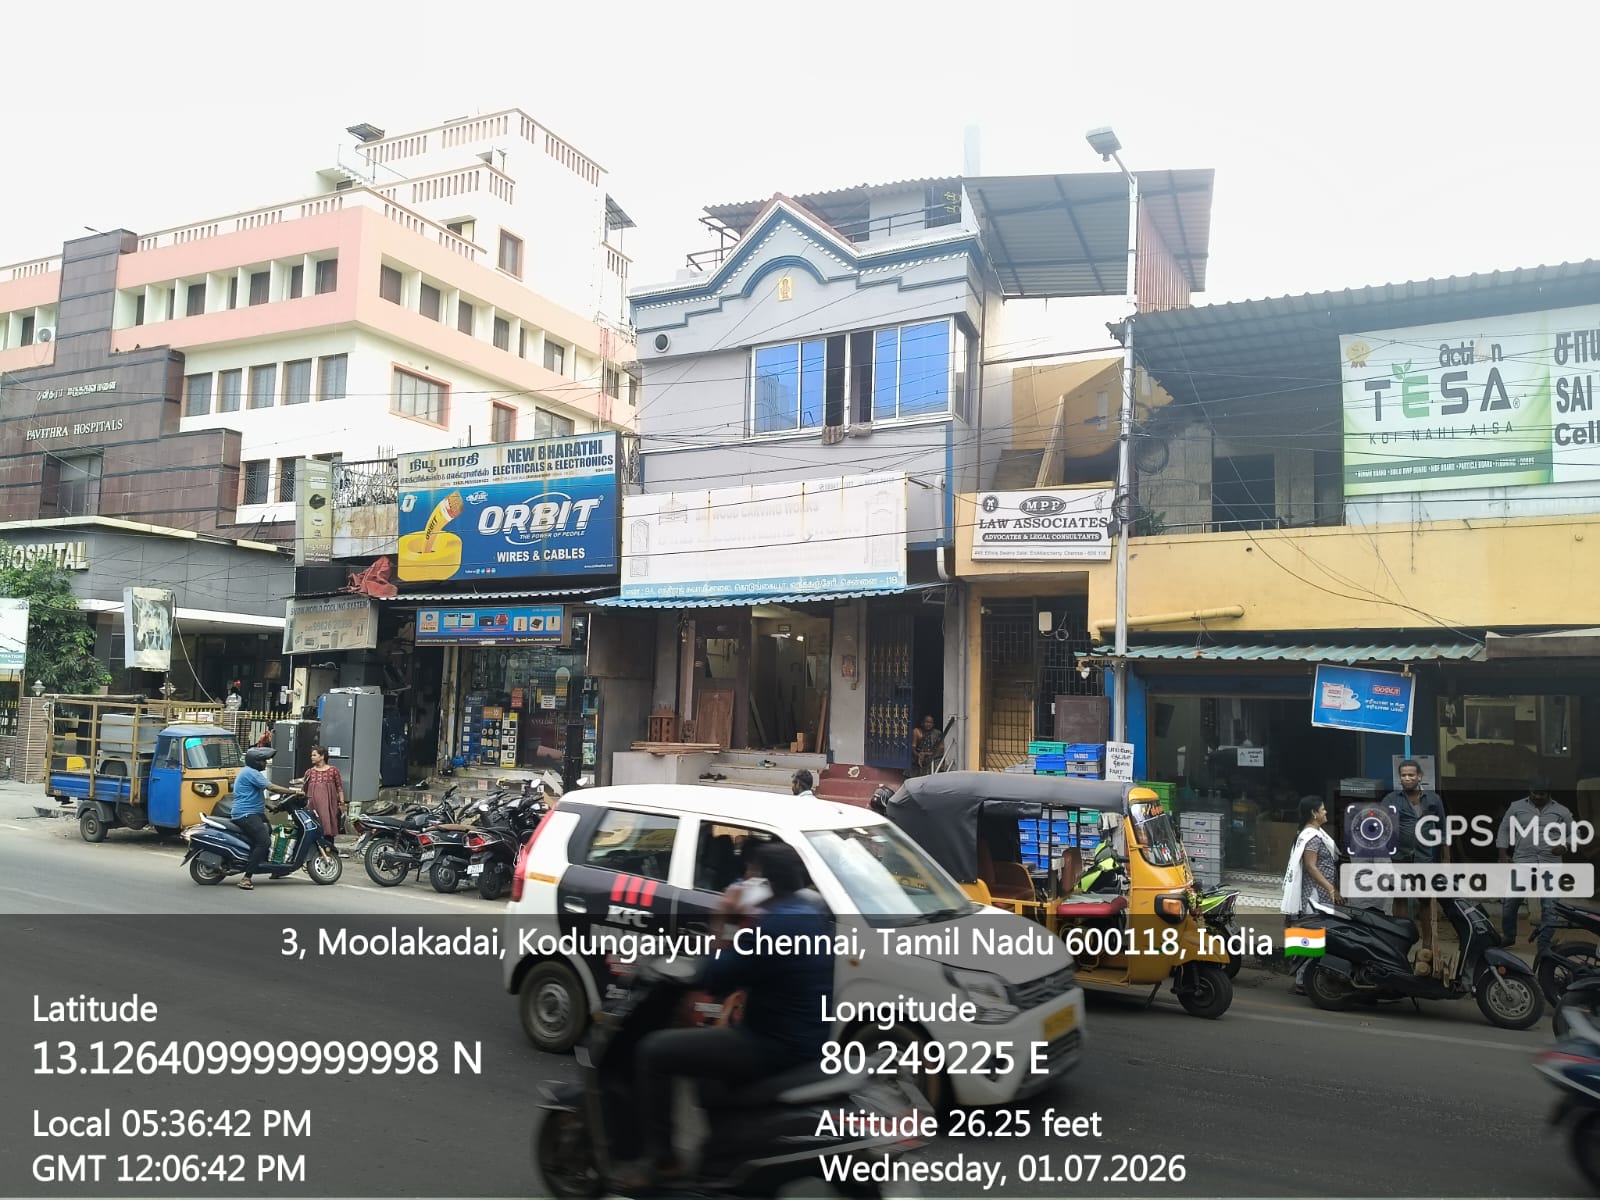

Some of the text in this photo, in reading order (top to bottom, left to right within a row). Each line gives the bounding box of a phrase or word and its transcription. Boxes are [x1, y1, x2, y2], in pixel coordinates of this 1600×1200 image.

[1439, 338, 1504, 368] actin
[1364, 366, 1512, 422] TESA
[1556, 374, 1593, 414] SAI
[26, 418, 123, 441] PAVITHRA HOSPITALS
[409, 452, 480, 474] நியூ பாரதி
[507, 439, 603, 464] NEW BHARATHI
[492, 454, 614, 476] ELECTRICALS & ELECTRONICS
[477, 498, 601, 535] ORBIT
[1024, 499, 1062, 512] MPP
[979, 517, 1108, 529] LAW ASSOCIATES
[984, 532, 1023, 541] ADVOCATES
[1029, 532, 1051, 540] LEGAL
[1051, 532, 1100, 540] CONSULTANTS
[497, 547, 586, 563] WIRES & CABLES
[605, 905, 655, 929] KFC
